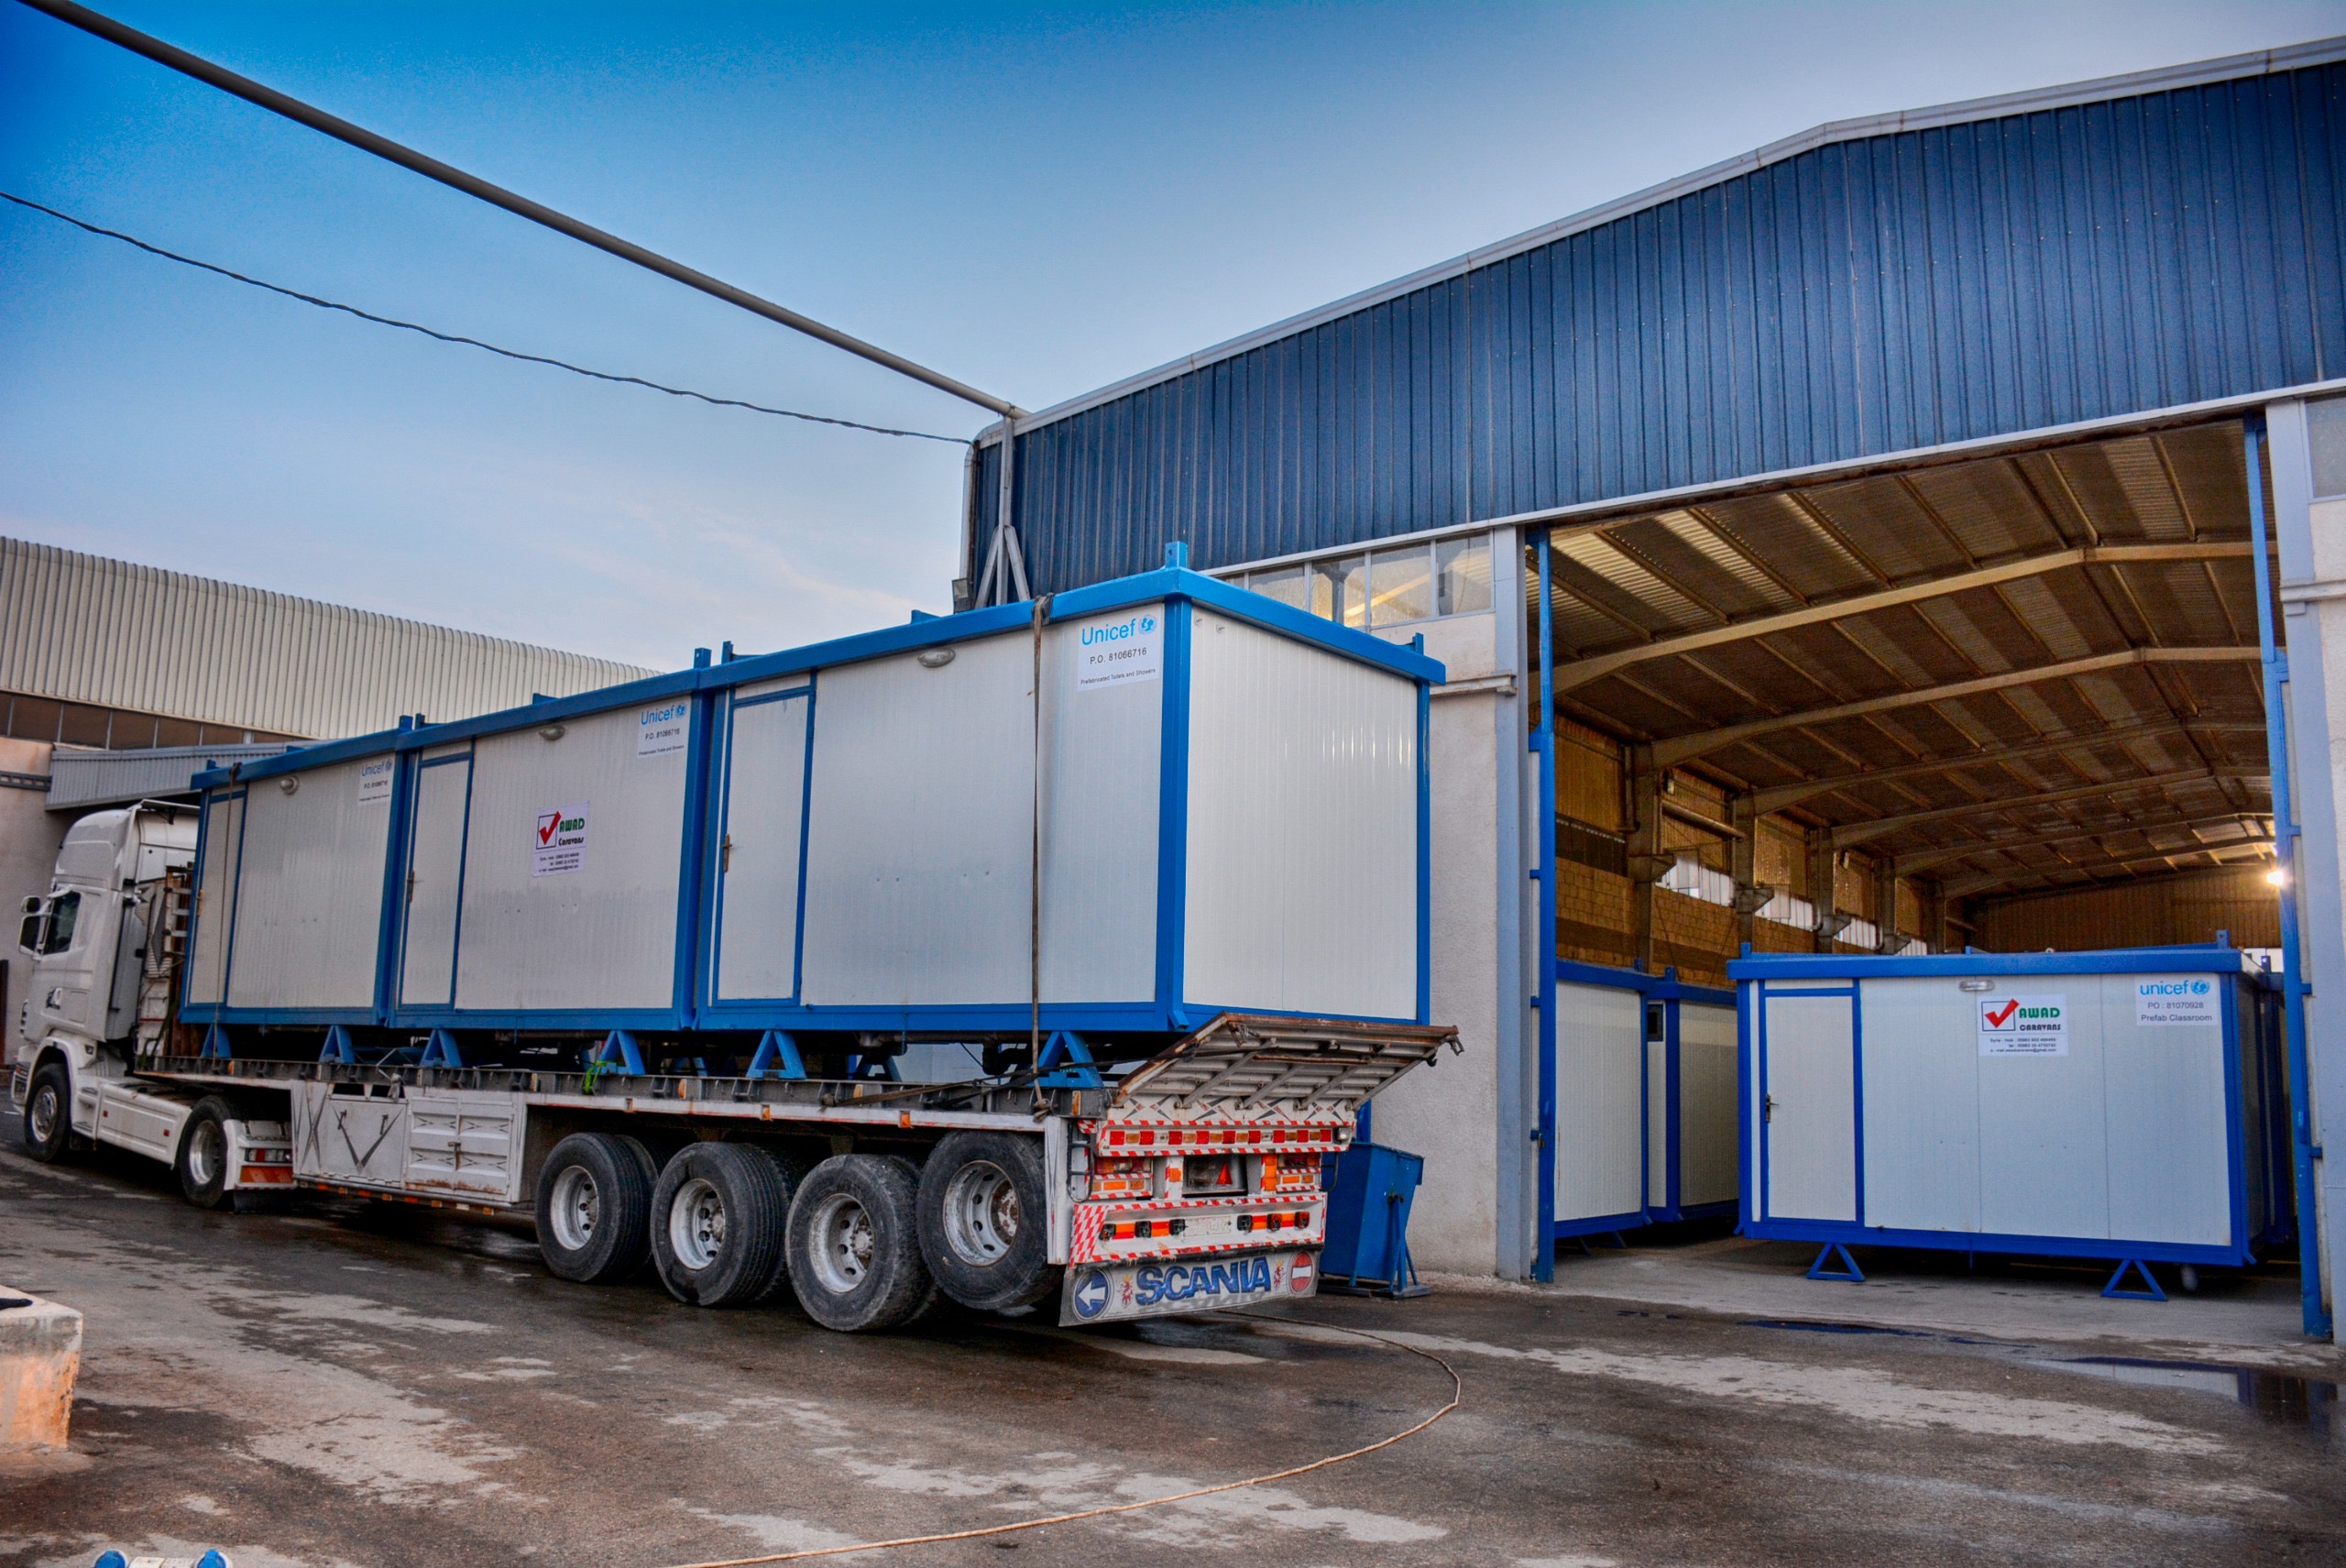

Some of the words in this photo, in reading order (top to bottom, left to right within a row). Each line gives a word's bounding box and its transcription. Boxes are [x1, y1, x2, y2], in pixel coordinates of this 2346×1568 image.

[1081, 619, 1136, 646] Unicef
[1090, 654, 1106, 664] P.O.
[1108, 647, 1147, 662] 81066716
[641, 705, 675, 726] Unicef
[559, 817, 586, 833] AWAD
[2140, 980, 2188, 995] unicef
[2019, 1007, 2061, 1019] AWAD
[2141, 1014, 2167, 1022] Prefab
[2169, 1014, 2213, 1022] Classroom
[1135, 1256, 1272, 1306] SCANIA
